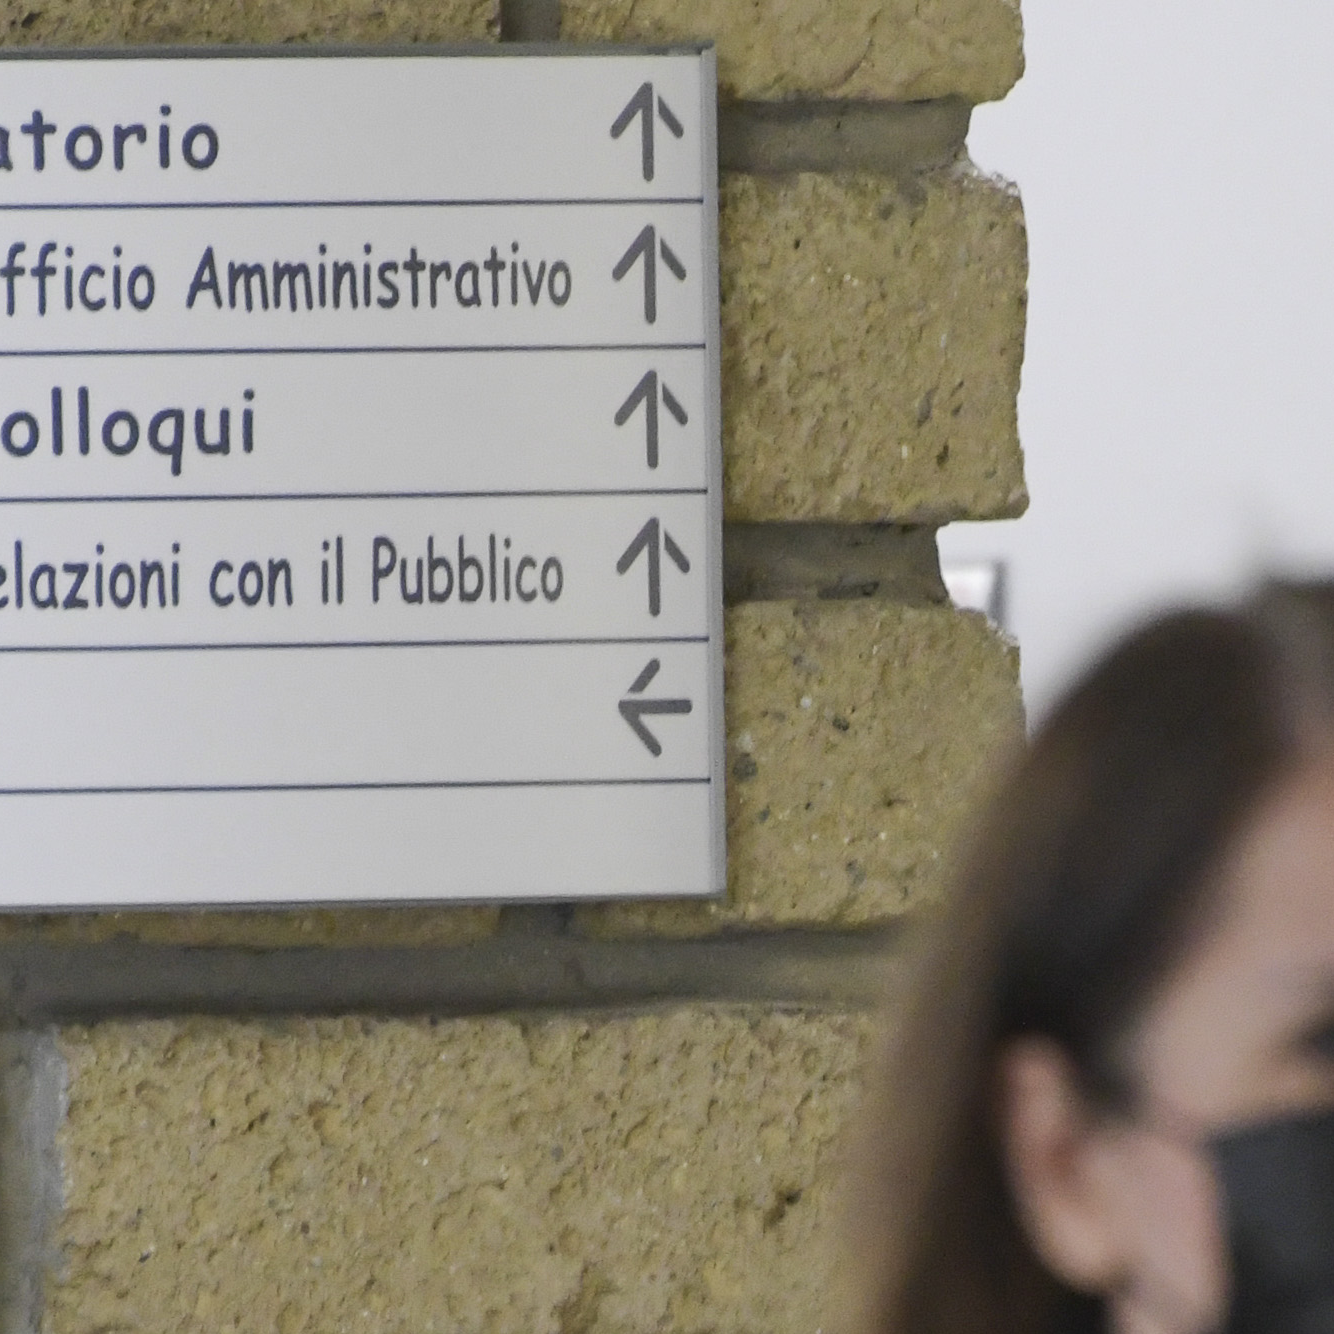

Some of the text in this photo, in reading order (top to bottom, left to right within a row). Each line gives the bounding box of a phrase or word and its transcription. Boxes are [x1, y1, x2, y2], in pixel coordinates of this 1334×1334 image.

[185, 241, 572, 314] Amministrativo
[208, 558, 294, 608] con
[321, 535, 344, 605] il
[371, 533, 564, 606] Pubblico
